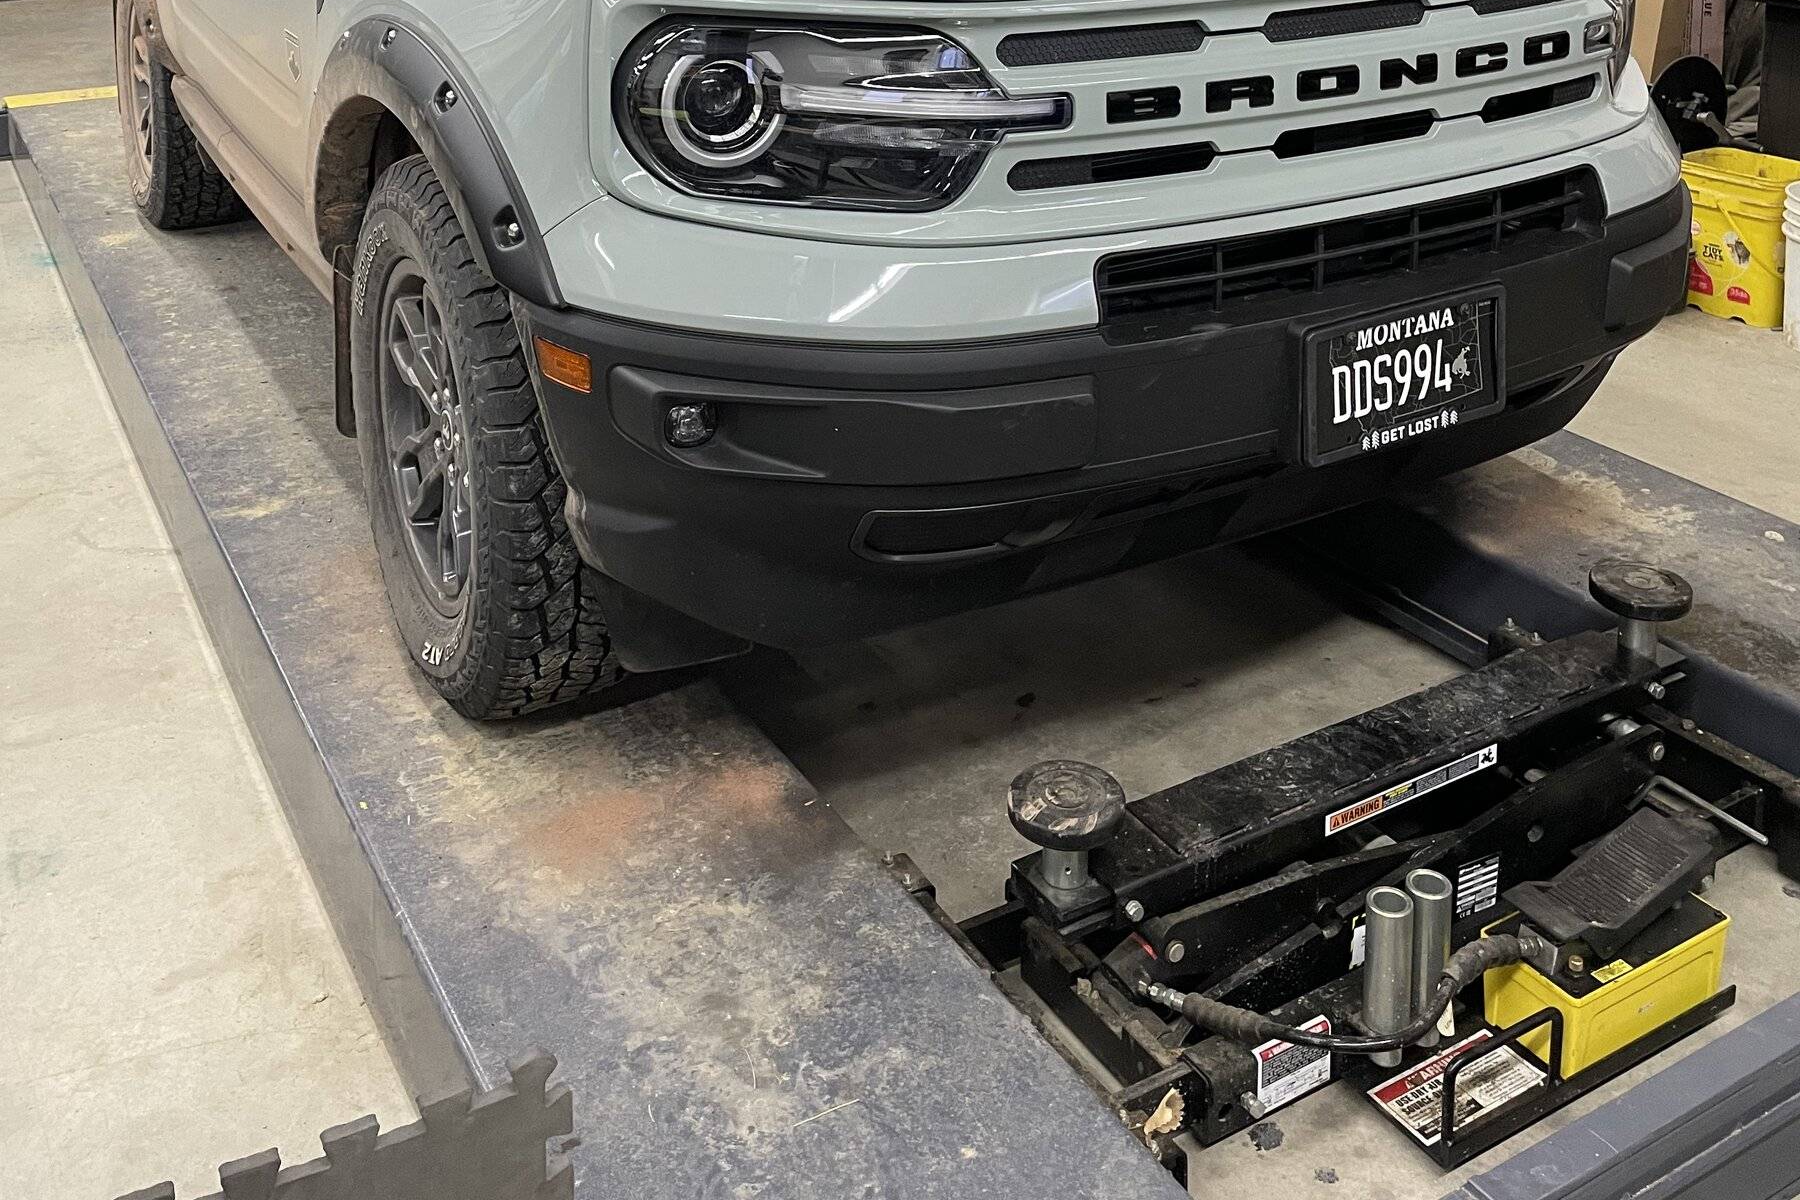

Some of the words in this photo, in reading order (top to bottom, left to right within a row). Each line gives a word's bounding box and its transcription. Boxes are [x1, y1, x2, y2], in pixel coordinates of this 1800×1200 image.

[1105, 31, 1571, 125] BRONCO
[1703, 244, 1722, 255] TIDY
[1355, 307, 1455, 352] MONTANA
[1331, 339, 1453, 425] DDS994
[1380, 425, 1405, 445] GET
[1408, 415, 1440, 437] LOST
[1340, 799, 1380, 824] WARNING
[1396, 1092, 1414, 1107] USE
